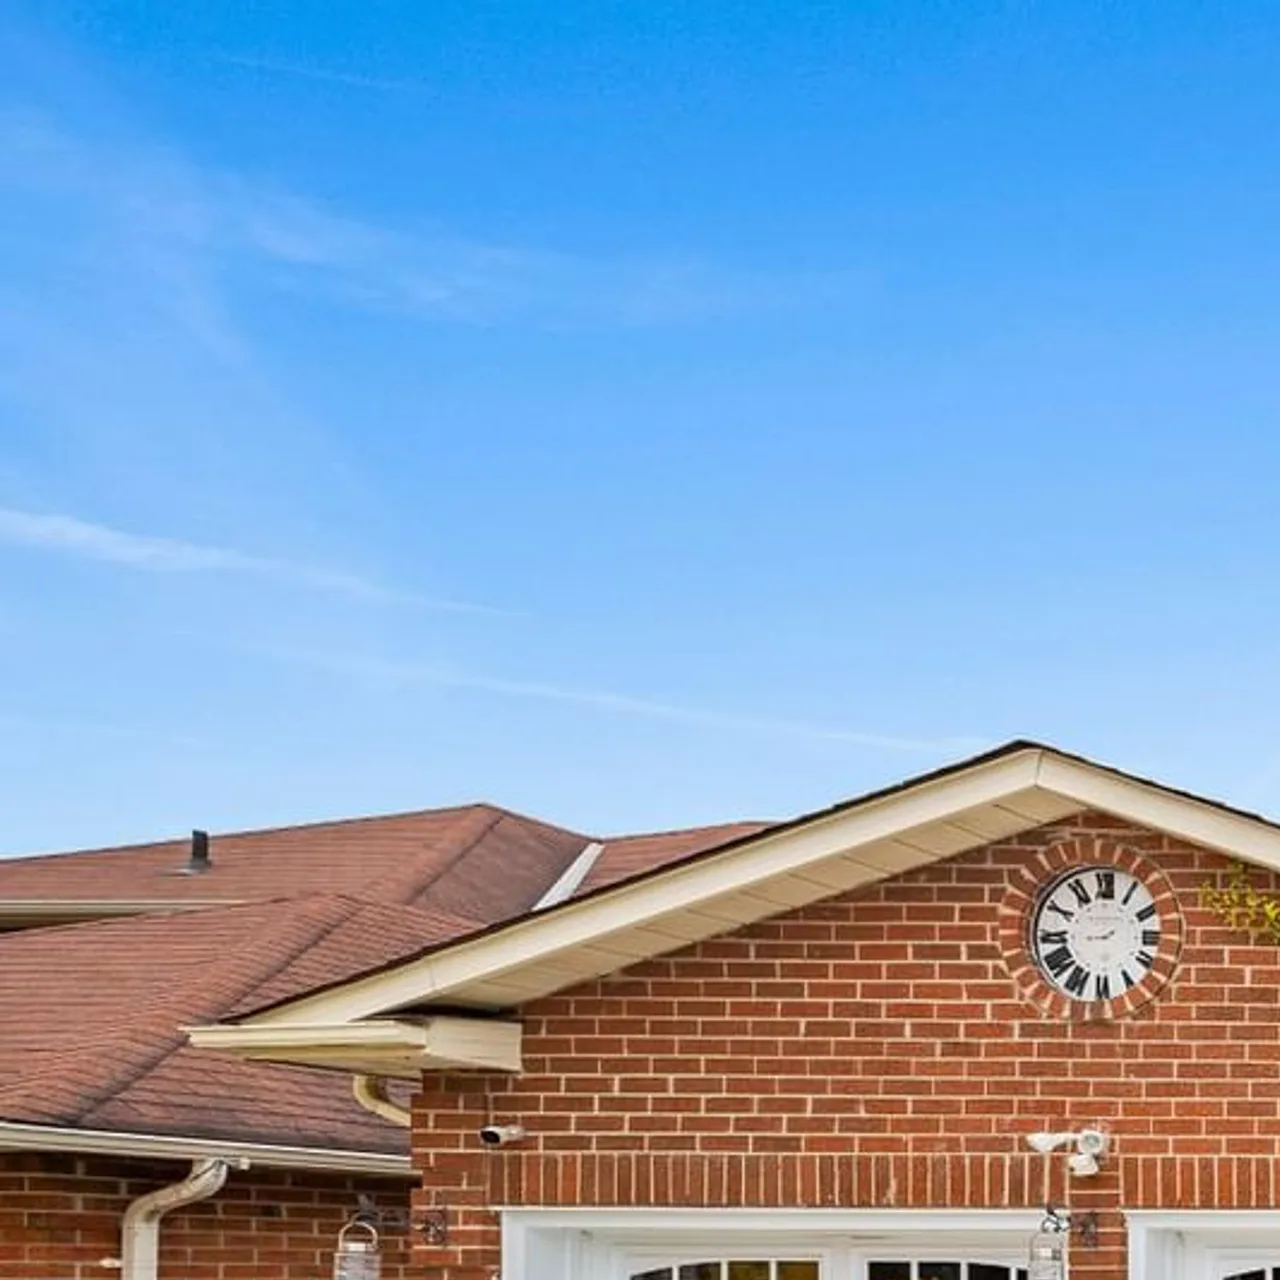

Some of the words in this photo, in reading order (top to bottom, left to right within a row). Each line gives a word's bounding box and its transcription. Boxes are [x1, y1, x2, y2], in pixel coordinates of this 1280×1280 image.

[1067, 878, 1091, 908] XI
[1095, 873, 1114, 899] XII
[1122, 881, 1139, 905] I
[1047, 900, 1075, 922] X
[1136, 904, 1156, 922] II
[1040, 928, 1069, 944] IX
[1142, 930, 1161, 946] III
[1096, 975, 1110, 999] VI
